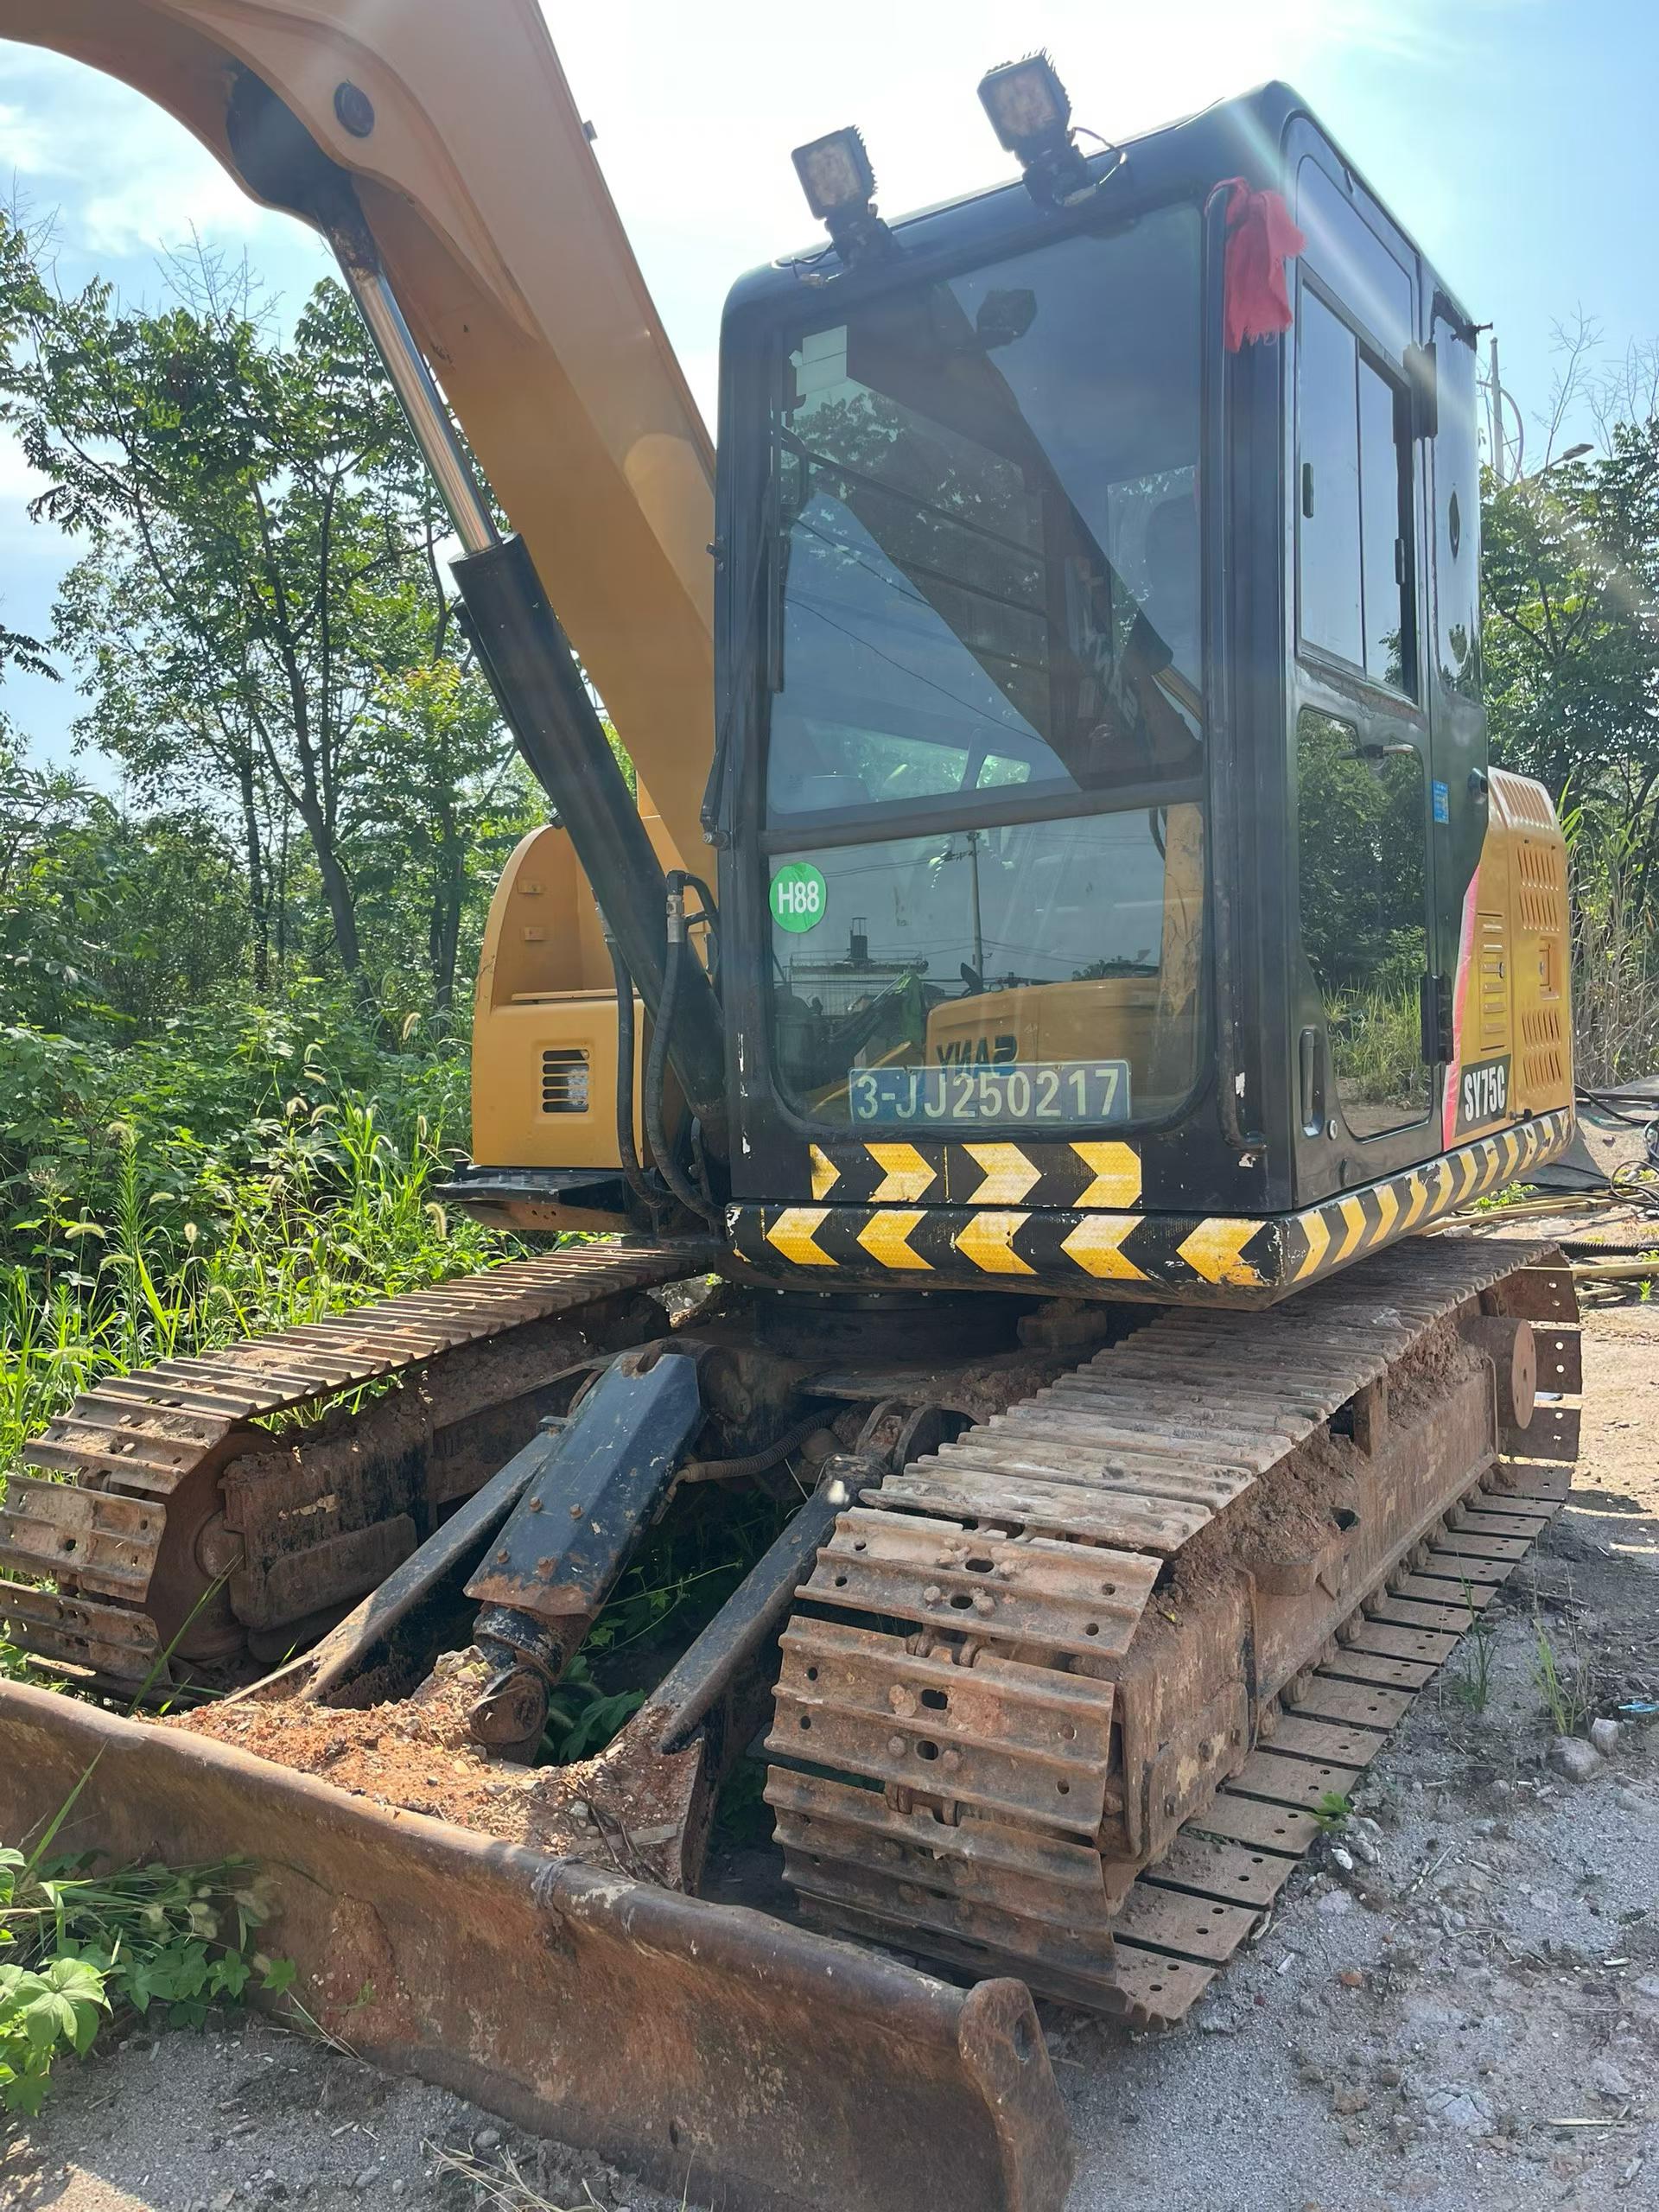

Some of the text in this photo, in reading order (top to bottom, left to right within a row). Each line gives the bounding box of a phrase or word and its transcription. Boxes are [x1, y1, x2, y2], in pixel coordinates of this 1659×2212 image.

[779, 880, 819, 913] H88
[857, 1069, 1119, 1119] 3-JJ250217
[1464, 1065, 1505, 1122] SY75C
